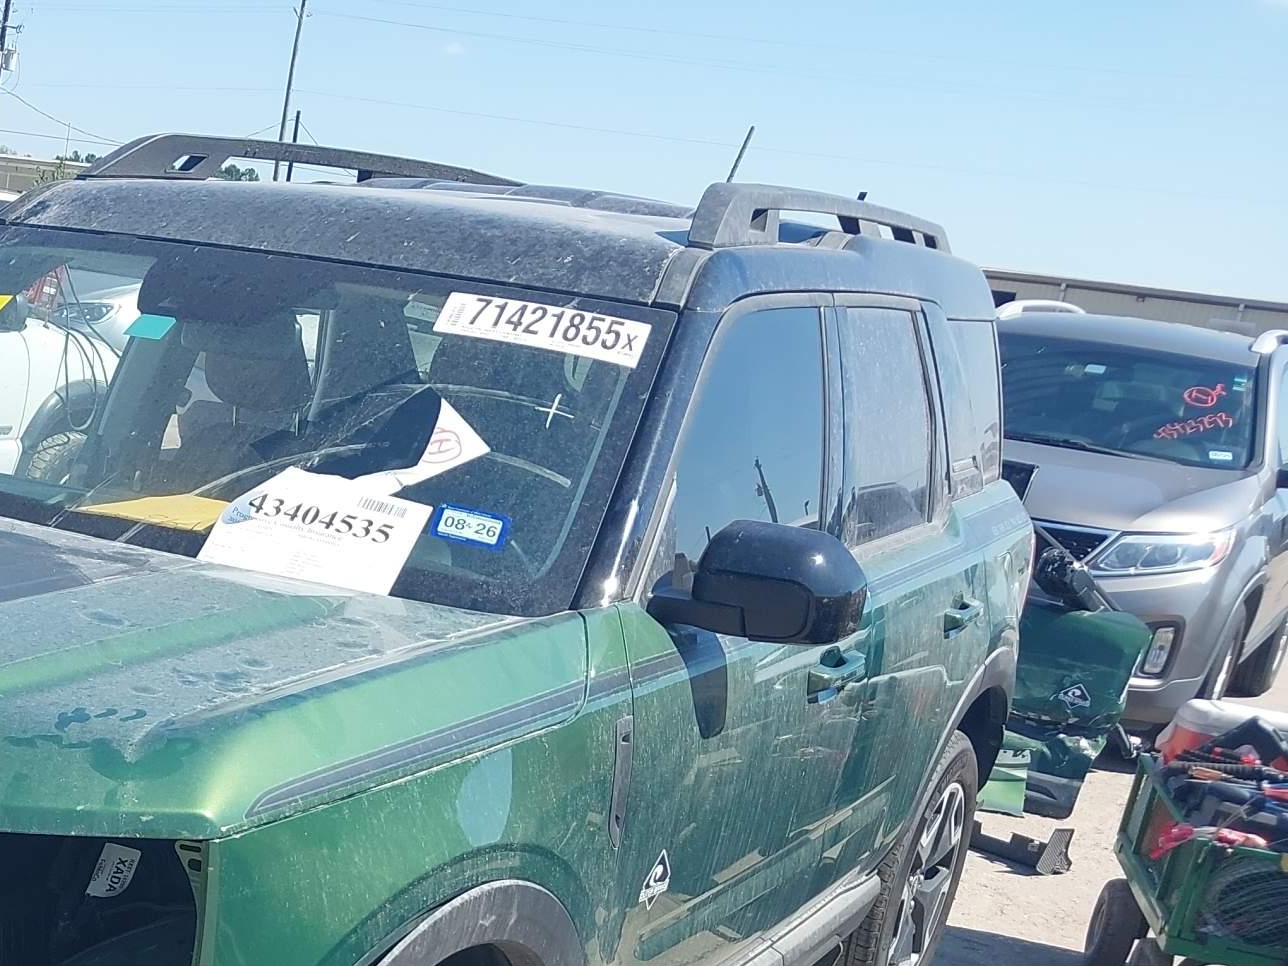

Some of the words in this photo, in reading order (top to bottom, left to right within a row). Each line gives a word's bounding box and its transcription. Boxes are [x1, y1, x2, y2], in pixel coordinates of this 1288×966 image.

[247, 493, 395, 544] 43404535
[444, 515, 467, 531] 08
[474, 522, 498, 538] 26
[105, 857, 129, 892] XADA
